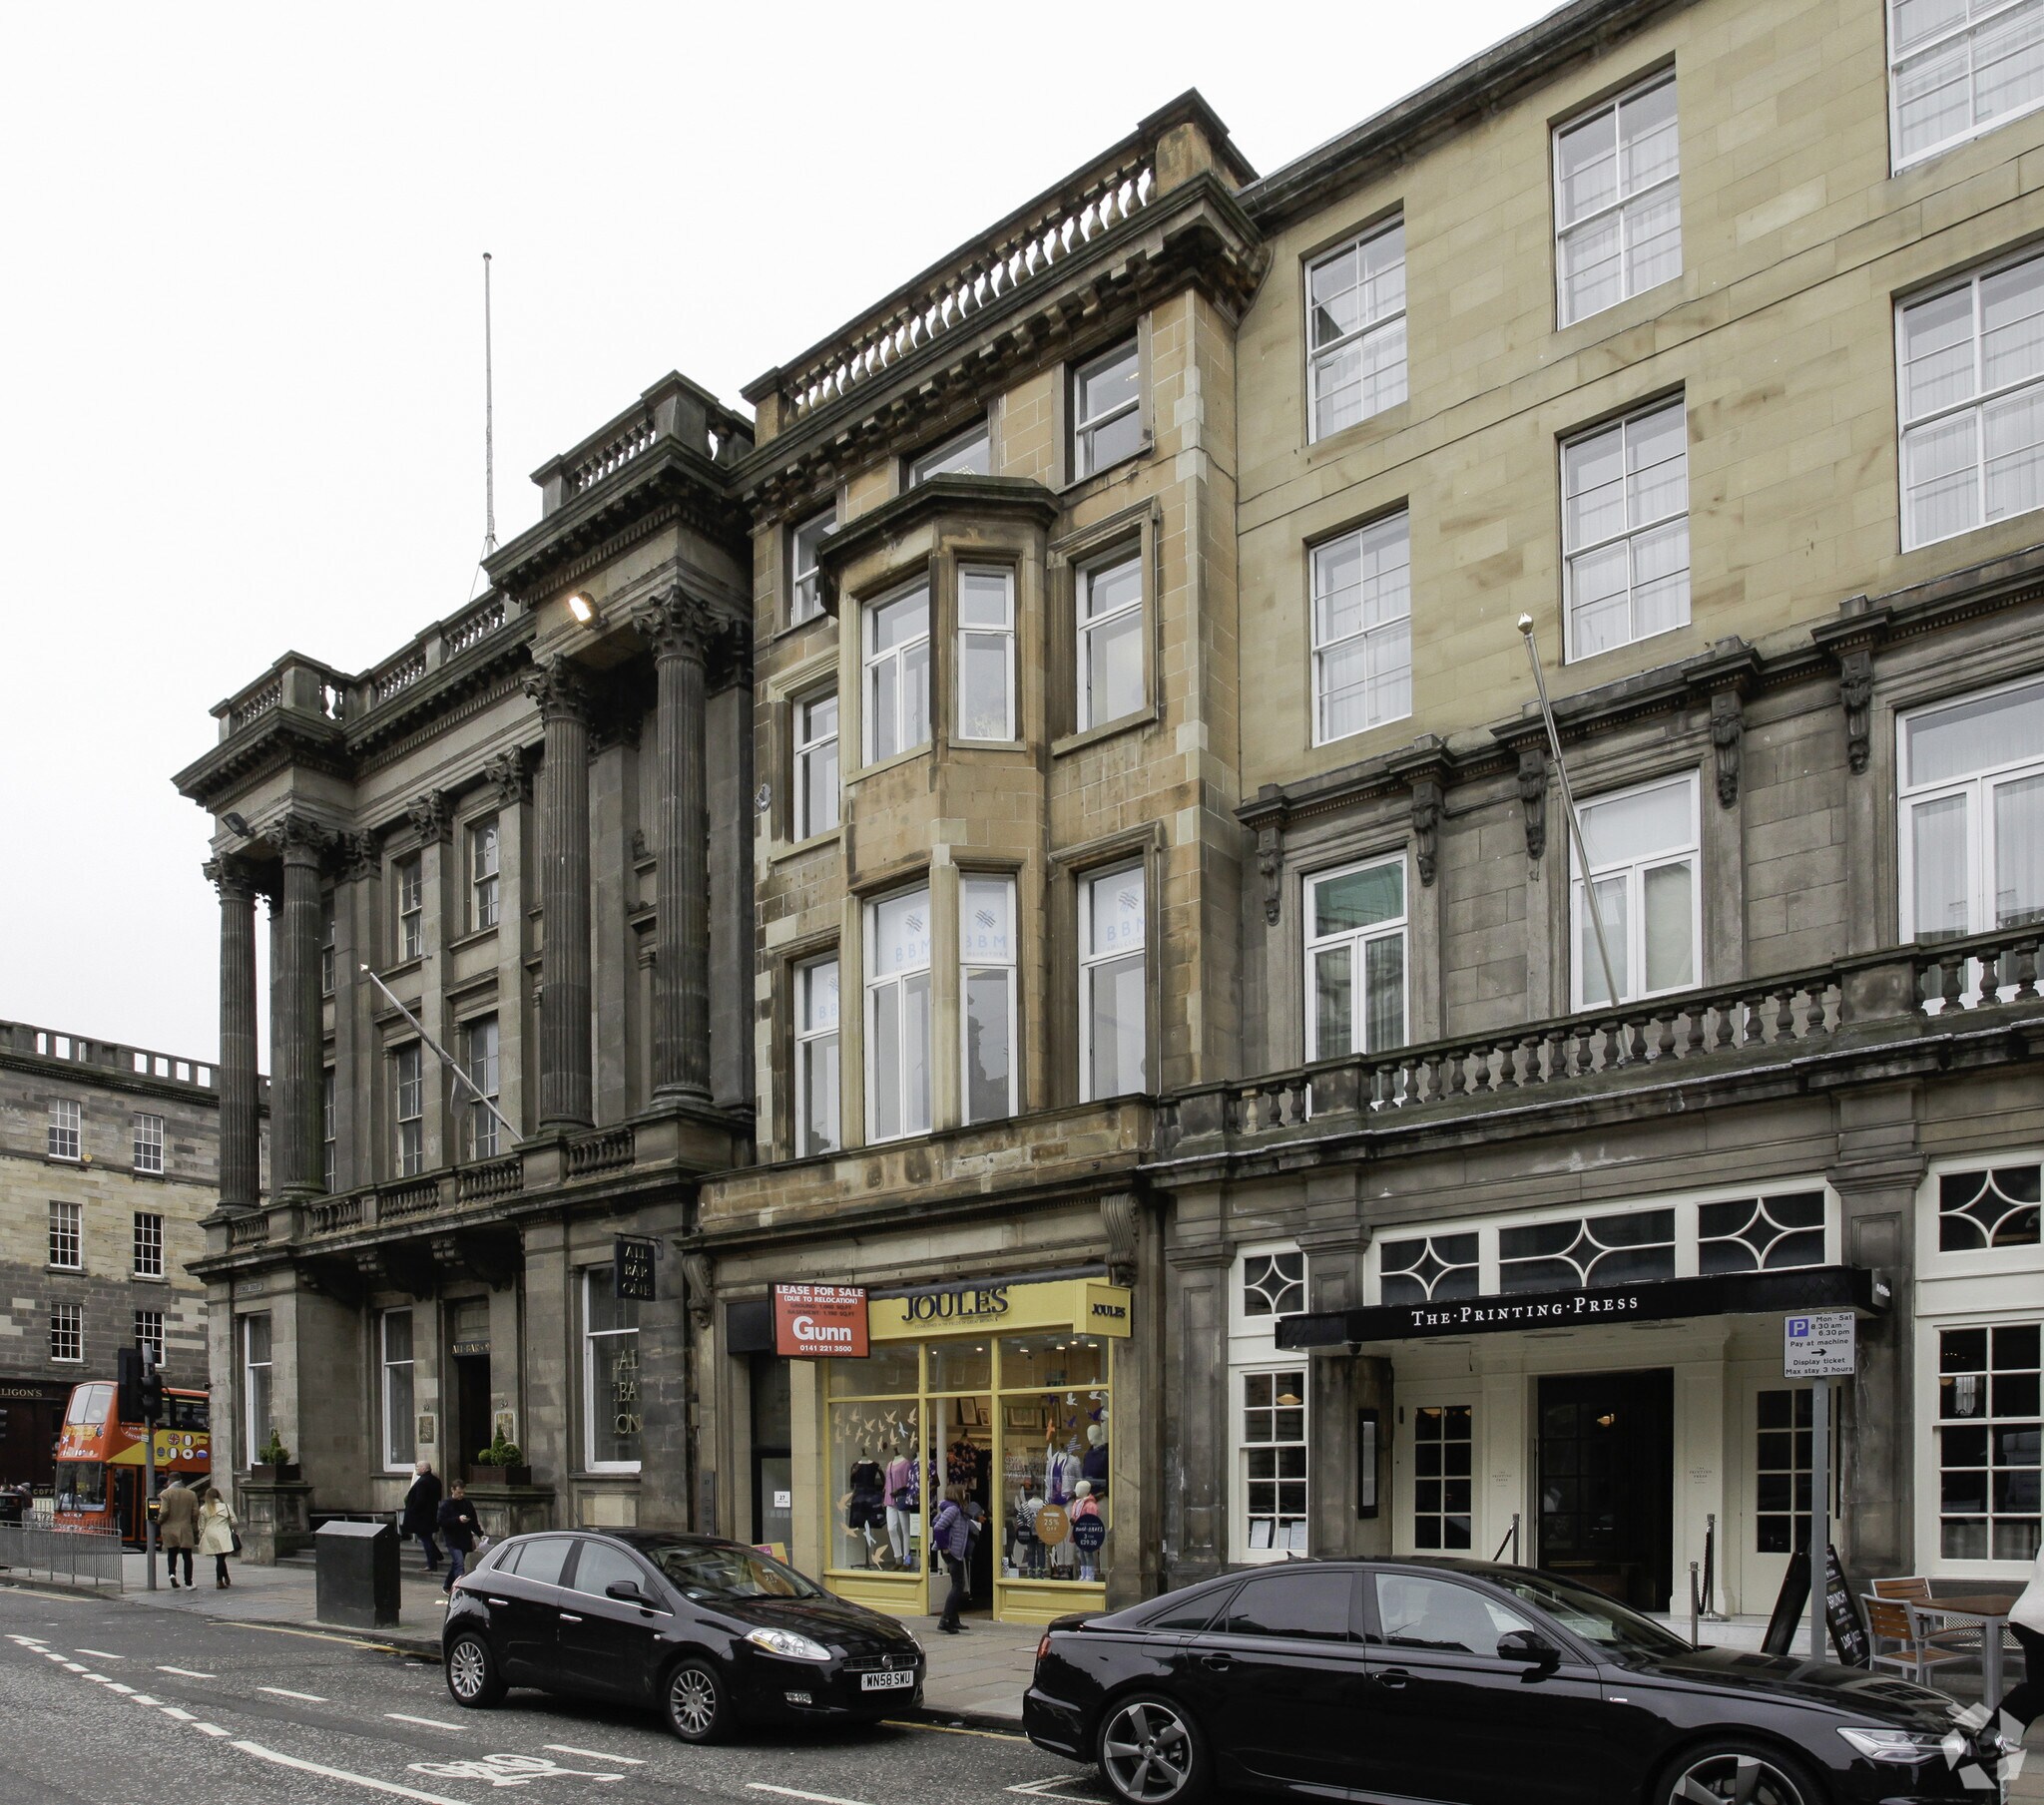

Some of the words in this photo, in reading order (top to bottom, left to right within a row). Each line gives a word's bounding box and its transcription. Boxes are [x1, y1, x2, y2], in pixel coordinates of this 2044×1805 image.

[625, 1246, 648, 1259] ALL
[625, 1264, 648, 1276] BAR
[623, 1283, 651, 1295] ONE
[776, 1285, 809, 1295] LEASE
[814, 1287, 834, 1296] FOR
[838, 1288, 863, 1297] SALE
[901, 1286, 1009, 1321] JOULES
[1092, 1303, 1126, 1318] JOULES
[1411, 1310, 1451, 1326] THE
[1460, 1303, 1563, 1323] PRINTING
[1574, 1297, 1638, 1313] PRESS
[792, 1316, 851, 1341] Gunn
[618, 1349, 640, 1370] AL
[0, 1388, 43, 1397] LIGON'S
[619, 1381, 640, 1401] BA
[615, 1414, 641, 1434] ON
[1826, 1589, 1848, 1609] BRUNCH
[866, 1673, 892, 1687] WN58
[894, 1672, 910, 1685] SWU
